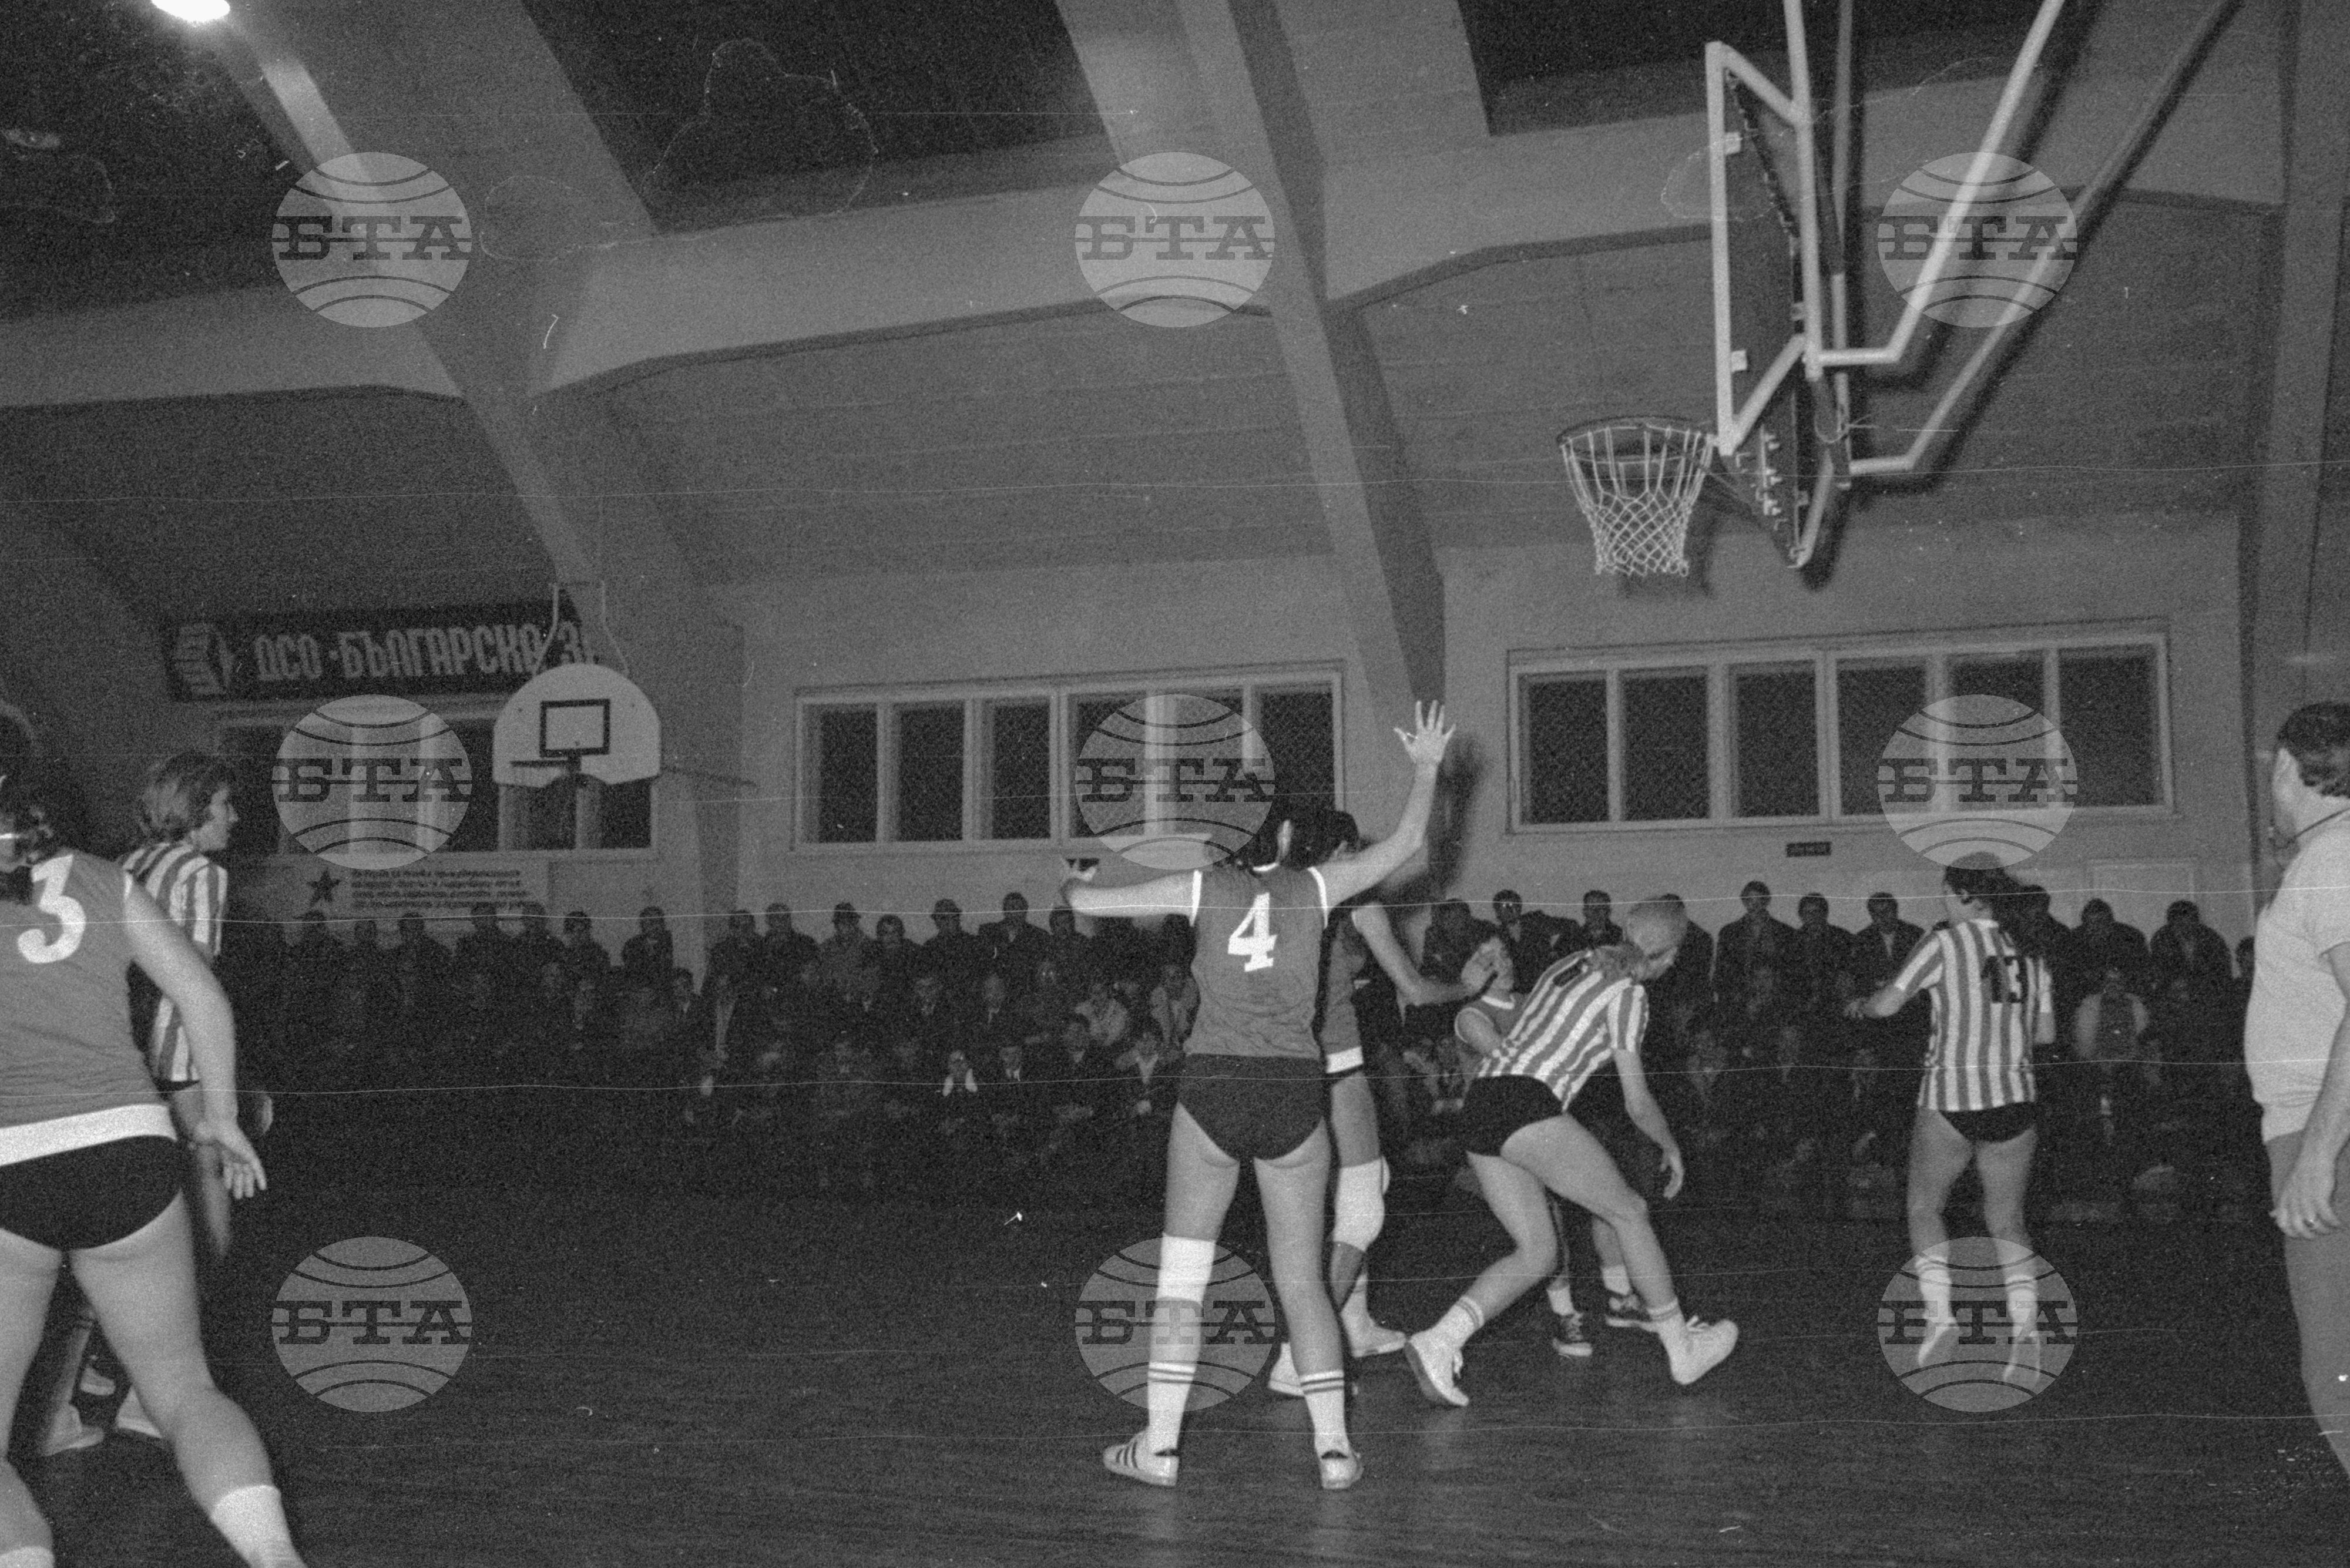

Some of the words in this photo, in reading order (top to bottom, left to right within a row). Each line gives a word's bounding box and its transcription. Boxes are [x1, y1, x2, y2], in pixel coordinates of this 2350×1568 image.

[254, 633, 323, 680] ДСО
[18, 854, 86, 963] 3
[1227, 892, 1277, 972] 4
